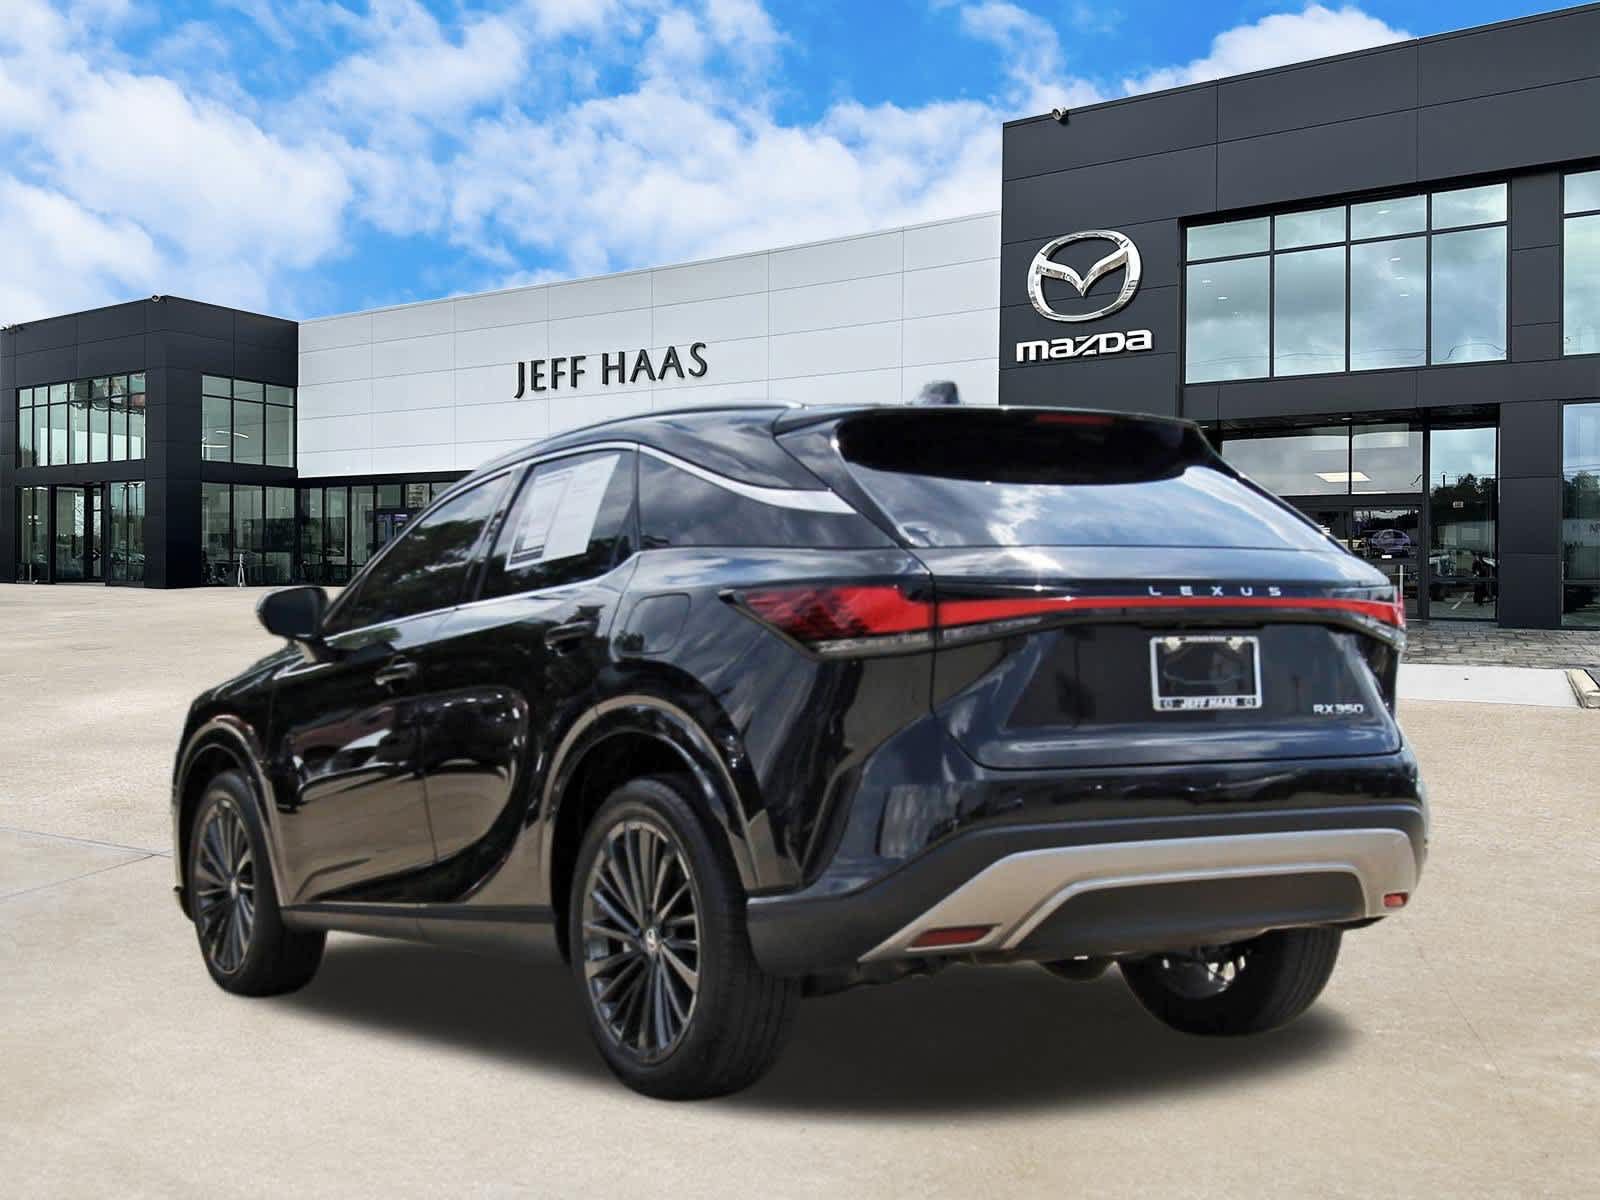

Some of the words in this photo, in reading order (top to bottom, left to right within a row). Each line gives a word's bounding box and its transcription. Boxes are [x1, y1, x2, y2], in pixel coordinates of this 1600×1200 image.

[514, 355, 586, 399] JEFF
[602, 342, 707, 385] HAAS
[1148, 585, 1281, 596] LEXUS
